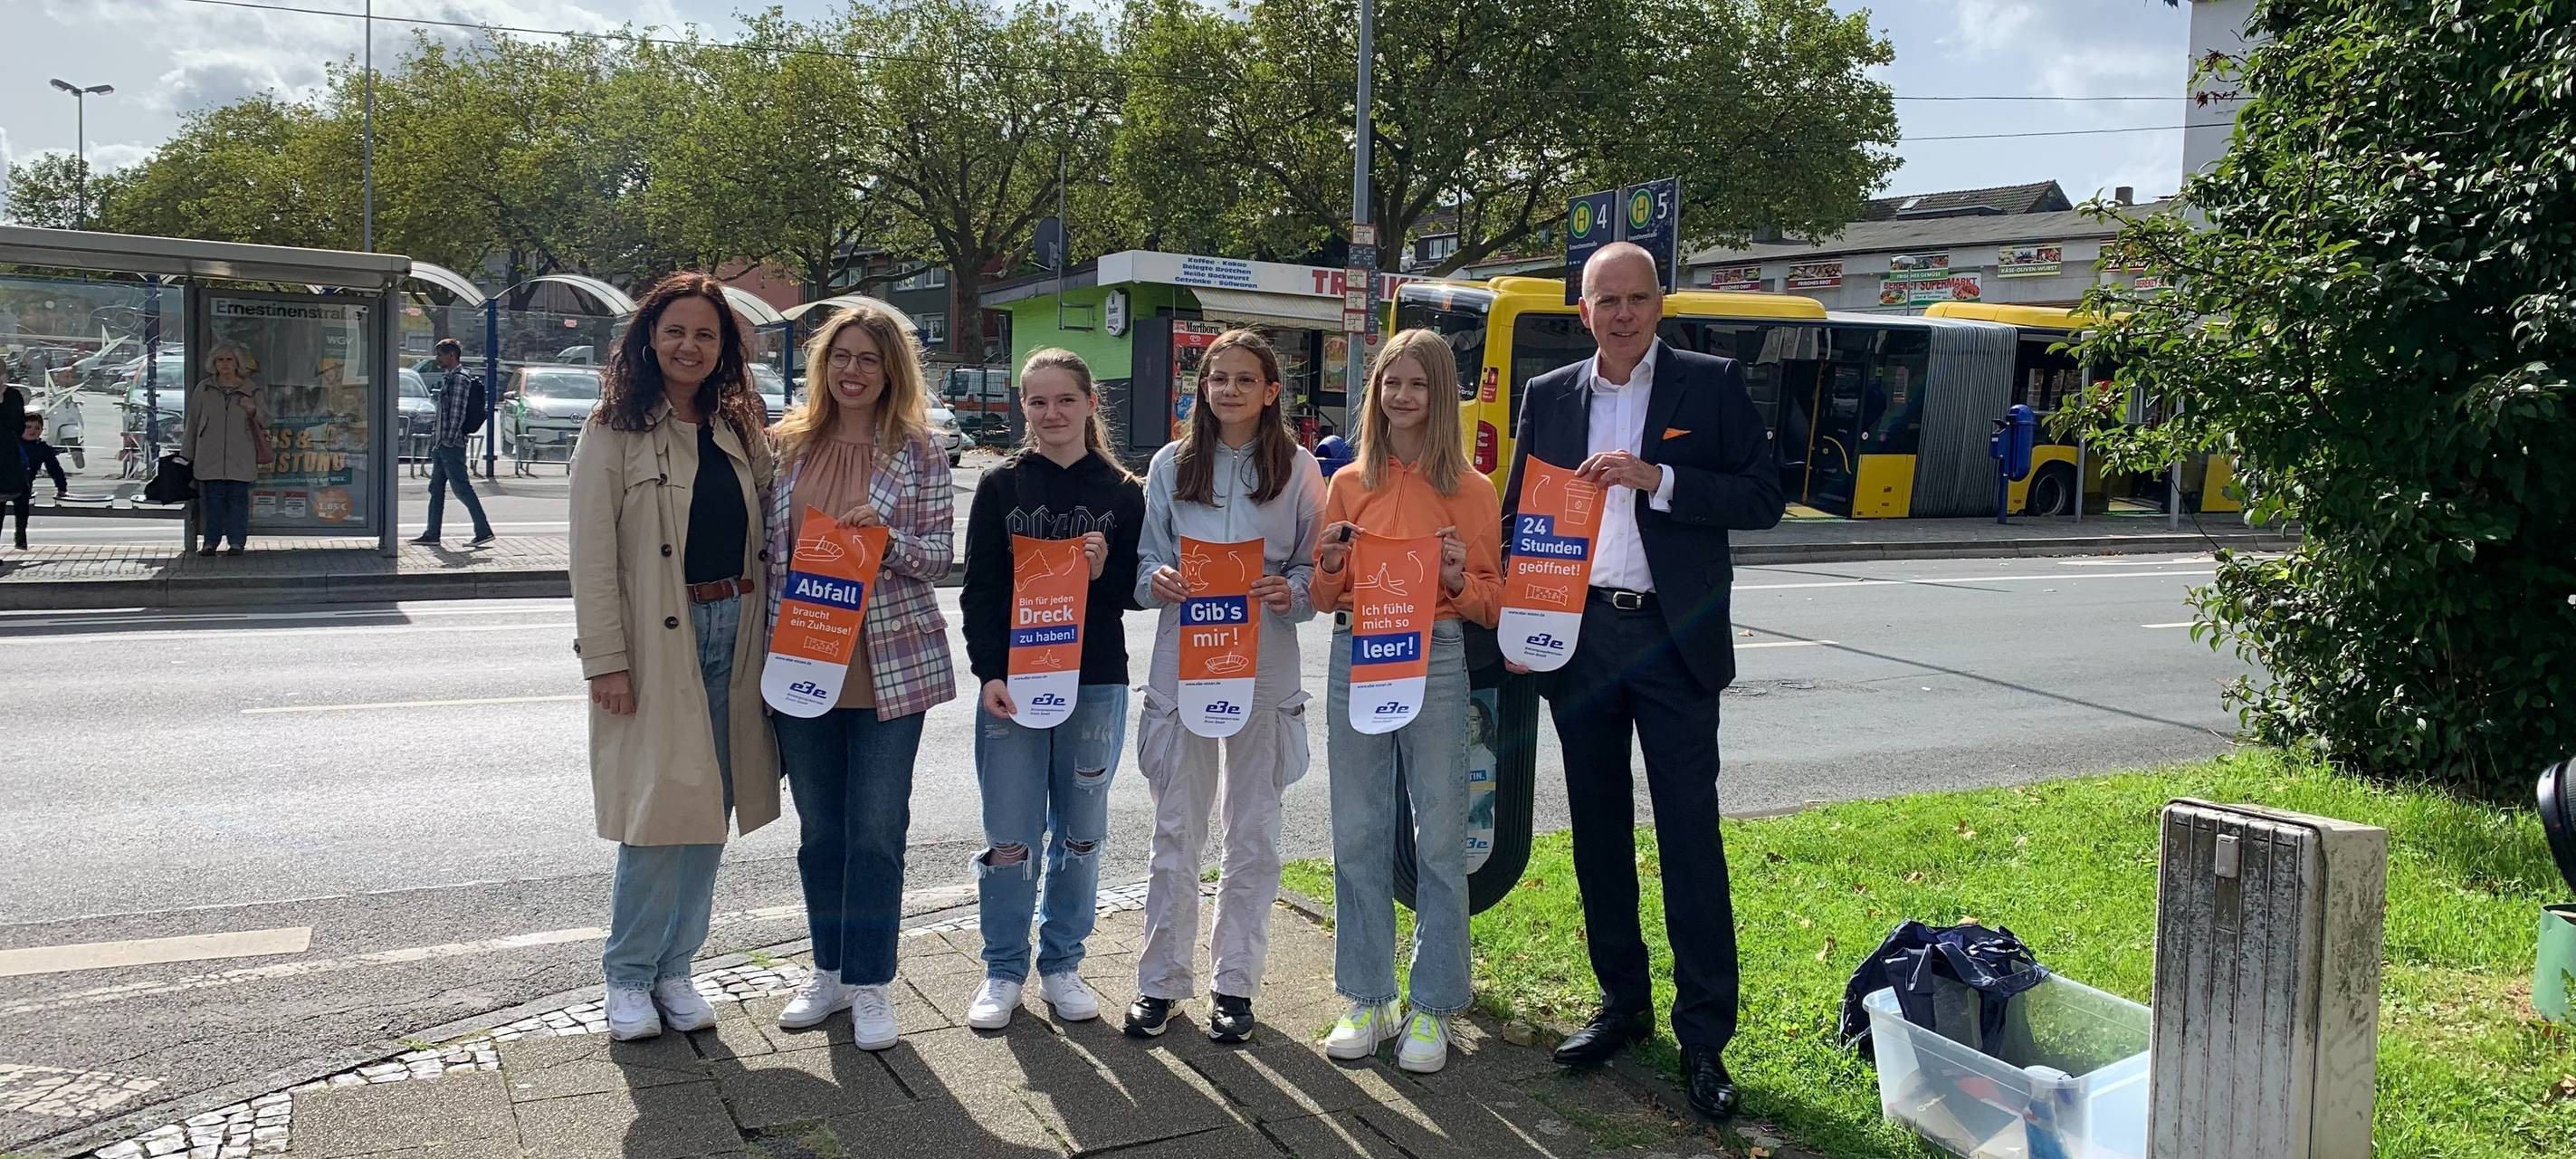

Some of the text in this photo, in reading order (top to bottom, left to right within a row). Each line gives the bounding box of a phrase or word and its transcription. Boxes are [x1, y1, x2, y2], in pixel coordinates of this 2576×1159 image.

[1656, 192, 1668, 219] 5
[1597, 203, 1608, 229] 4
[1182, 263, 1251, 275] Belegte Brötchen
[1222, 260, 1247, 268] Kakao
[1175, 276, 1258, 289] Getränke Süßwaren
[1207, 273, 1250, 282] Bockwurst
[1920, 277, 1978, 291] SUPERMARKT
[216, 300, 362, 321] Ernestinenstraße
[1186, 321, 1219, 334] Marlboro
[1522, 517, 1547, 535] 24
[1520, 538, 1582, 556] Stunden
[1518, 560, 1580, 576] geöffnet!
[795, 578, 857, 605] Abfall
[1018, 595, 1074, 607] Bin für jeden
[1361, 602, 1415, 616] Ich fühle
[792, 605, 830, 620] braucht
[1019, 606, 1074, 625] Dreck
[790, 618, 852, 636] ein Zuhause!
[1362, 618, 1409, 630] mich so
[1019, 628, 1075, 644] zu haben!
[1363, 637, 1414, 659] leer!
